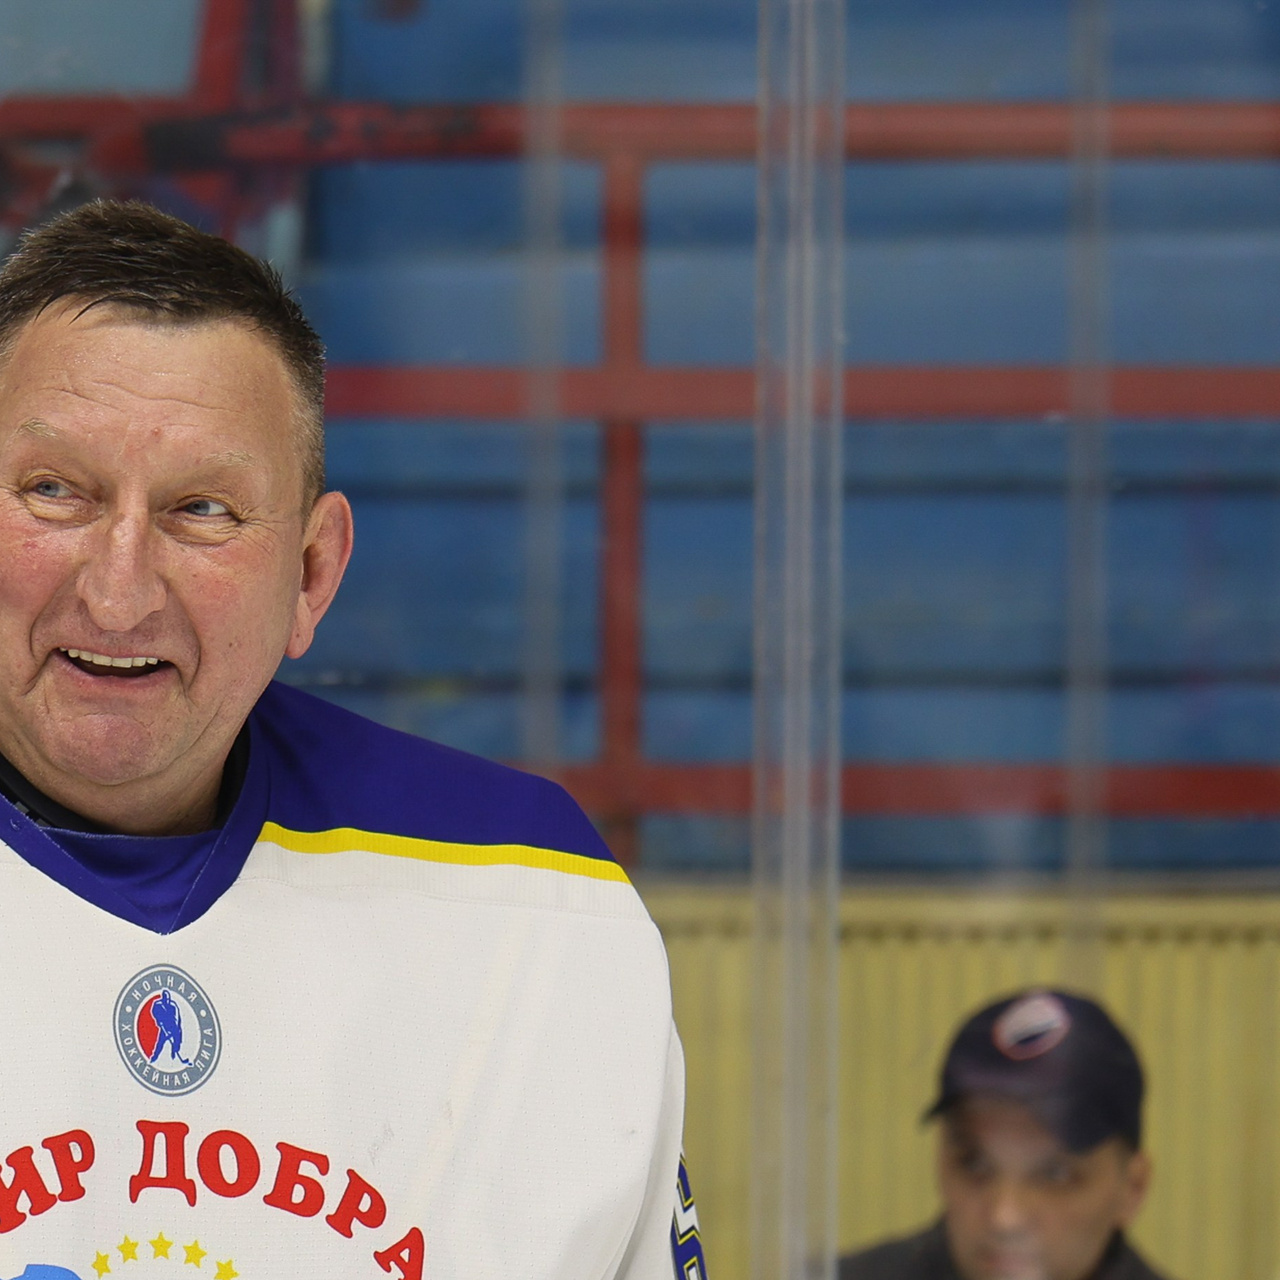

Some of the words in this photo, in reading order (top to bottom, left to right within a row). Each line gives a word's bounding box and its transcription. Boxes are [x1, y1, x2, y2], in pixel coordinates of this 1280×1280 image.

[131, 975, 198, 1003] НОЧНАЯ
[121, 1023, 191, 1086] ХОККЕЙНАЯ
[195, 1027, 214, 1072] ЛИГА
